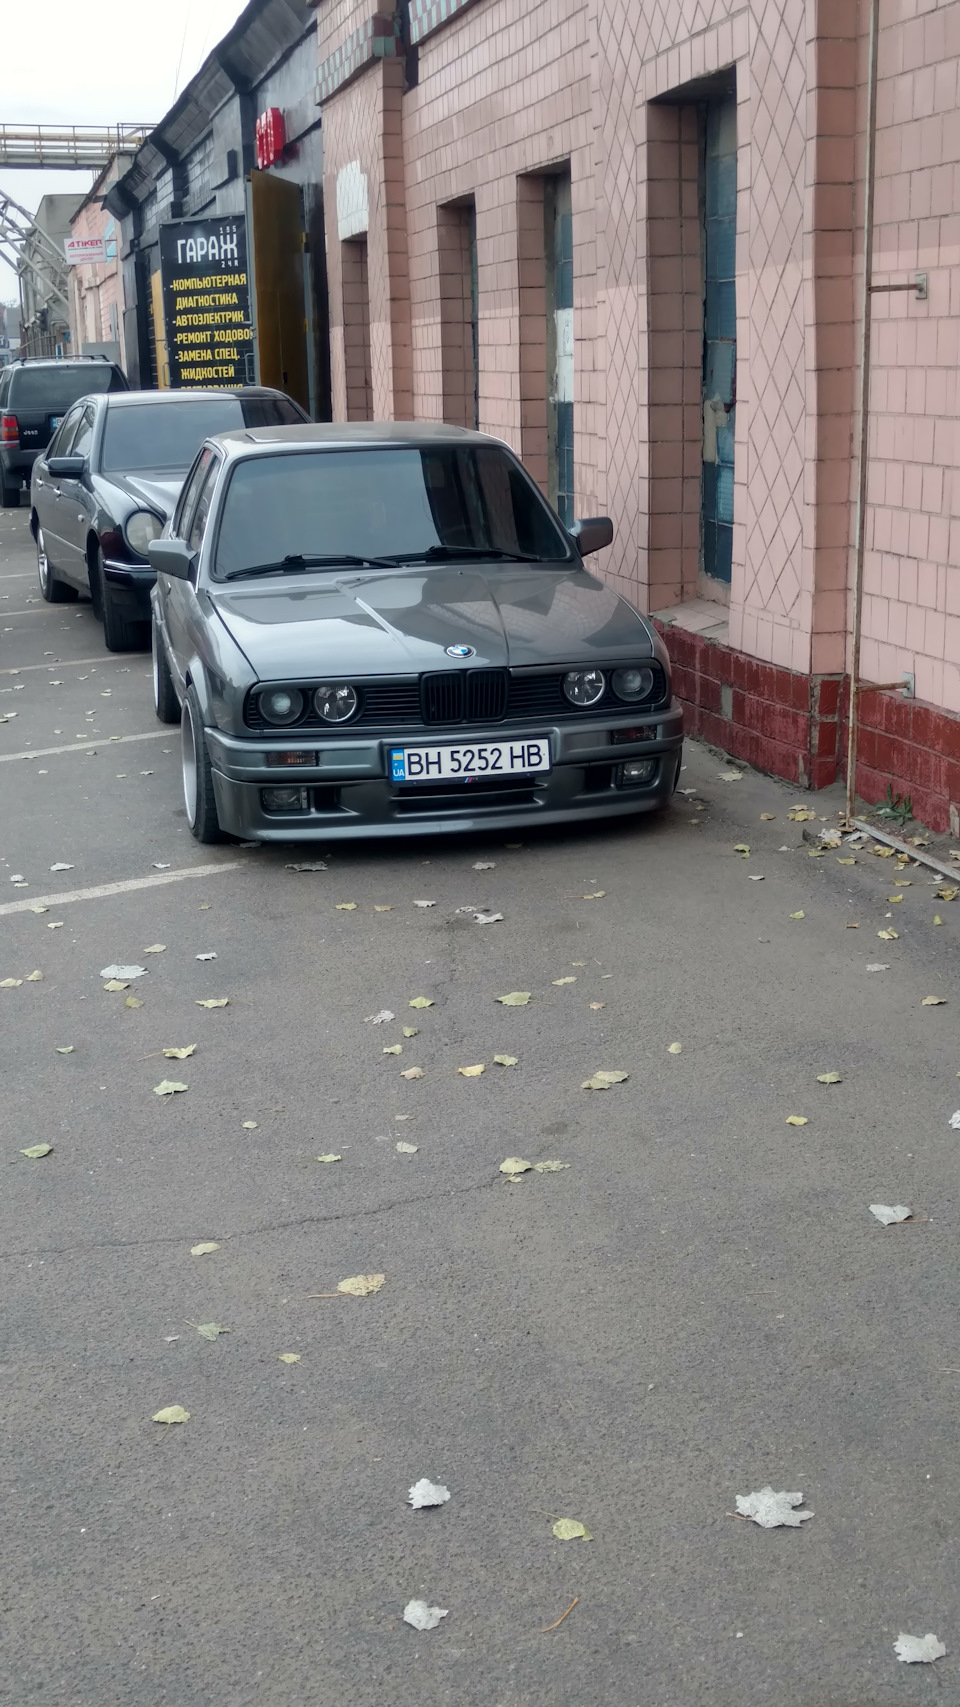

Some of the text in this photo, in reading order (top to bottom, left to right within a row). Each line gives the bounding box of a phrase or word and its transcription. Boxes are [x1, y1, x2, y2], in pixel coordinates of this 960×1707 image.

[68, 239, 102, 248] ATIKER
[177, 233, 238, 264] ГАРАЖ
[176, 292, 238, 310] ДИАГНОСТИКА
[214, 347, 240, 360] СПЕЦ.
[181, 363, 235, 380] ЖИДКОСТЕЙ
[407, 744, 543, 776] BH 5252 HB
[393, 768, 405, 777] UA
